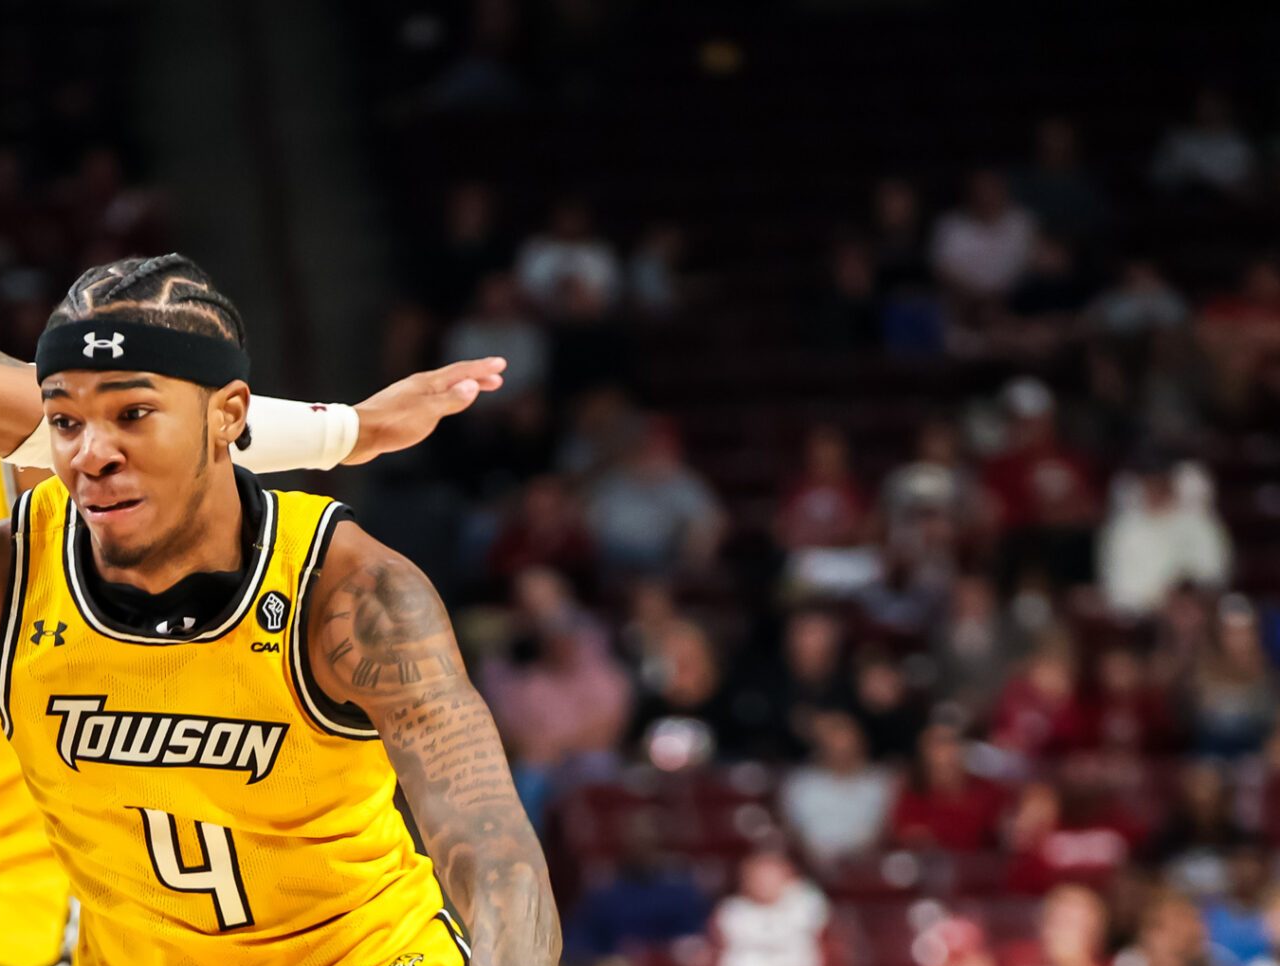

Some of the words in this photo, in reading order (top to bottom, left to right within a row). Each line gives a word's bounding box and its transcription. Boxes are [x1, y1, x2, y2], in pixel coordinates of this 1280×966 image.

[250, 641, 280, 654] CAA
[46, 694, 290, 786] TOWSON
[123, 805, 255, 932] 4
